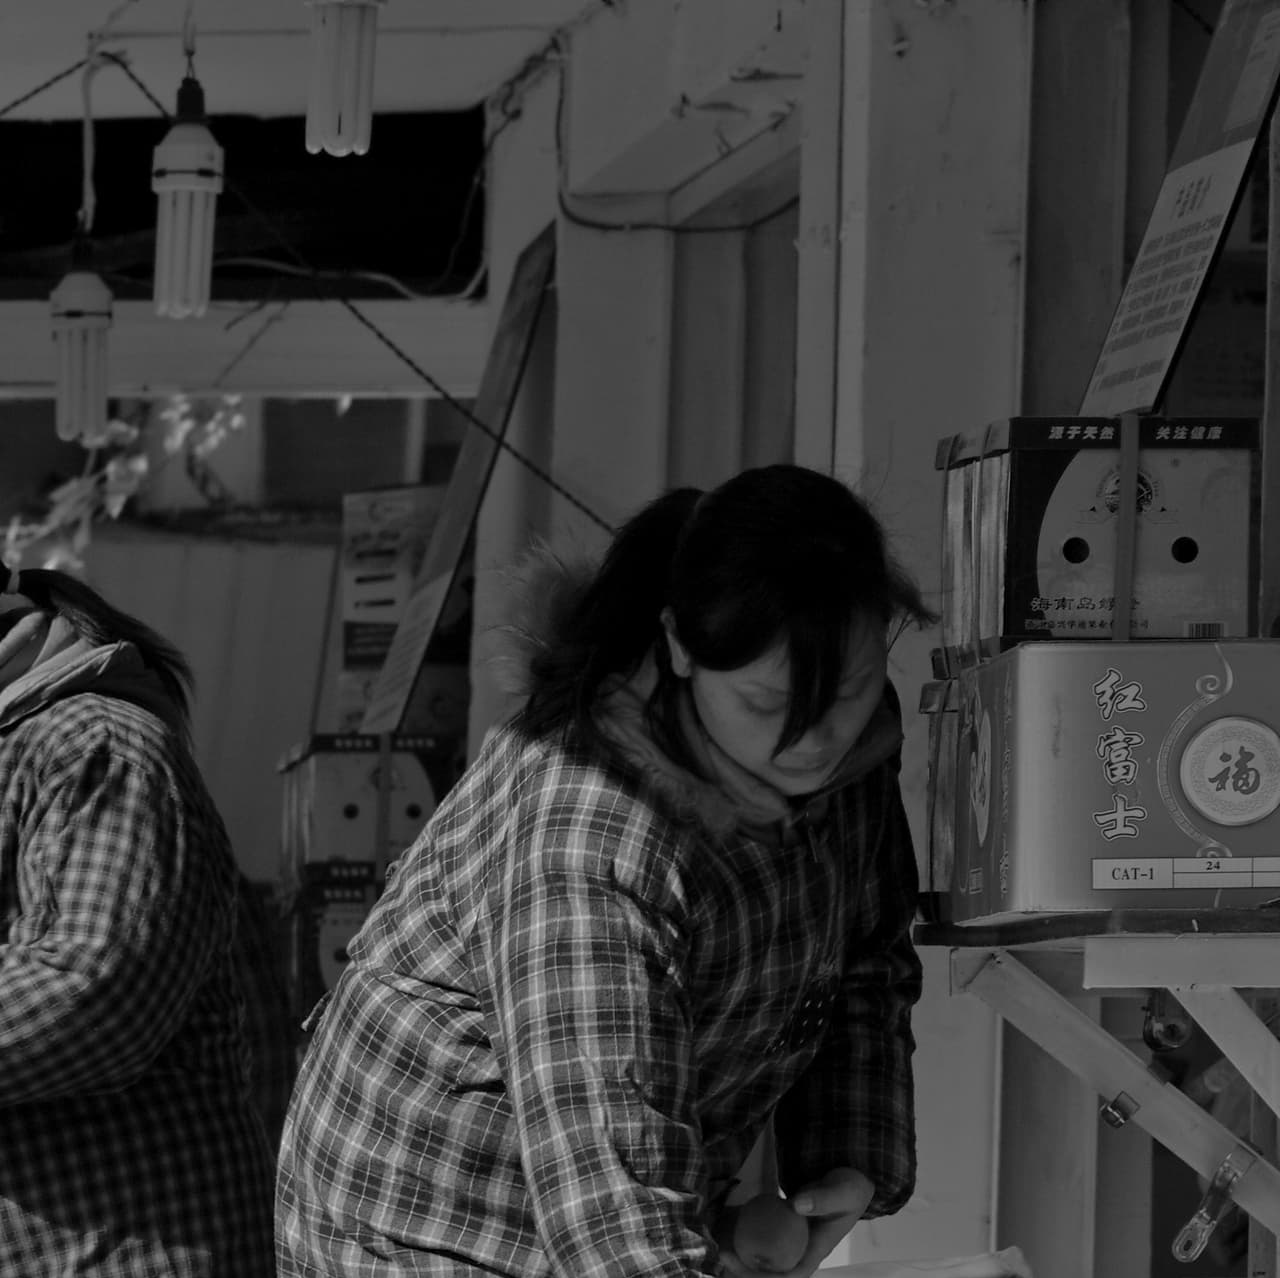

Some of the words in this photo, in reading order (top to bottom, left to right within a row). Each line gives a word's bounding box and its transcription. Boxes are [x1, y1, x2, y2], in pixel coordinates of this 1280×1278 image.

[1154, 426, 1224, 441] 关注健康
[1093, 667, 1147, 841] 红富士
[1207, 746, 1261, 796] 福
[1205, 860, 1221, 871] 24
[1111, 867, 1155, 881] CAT-1
